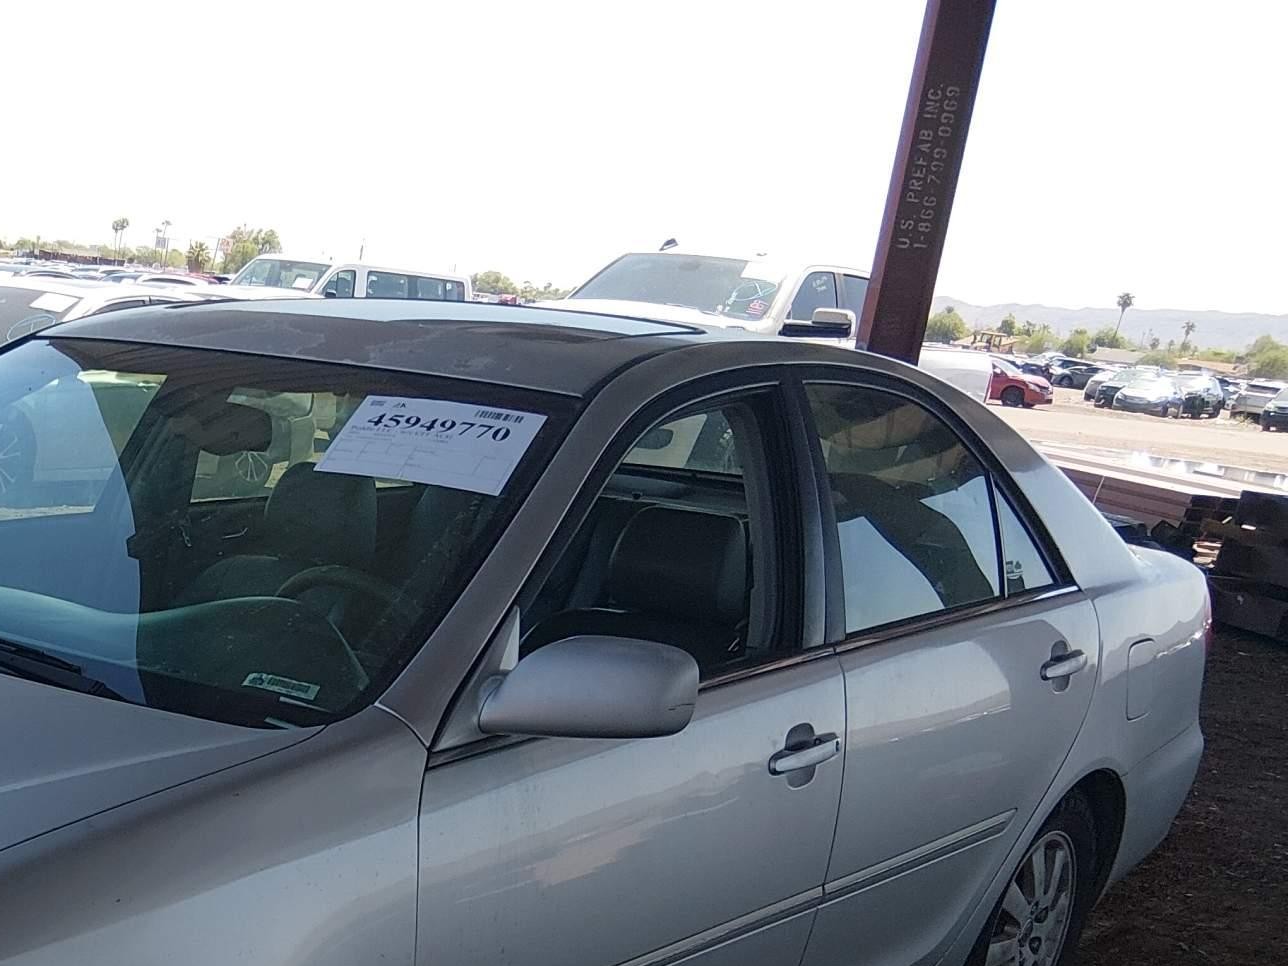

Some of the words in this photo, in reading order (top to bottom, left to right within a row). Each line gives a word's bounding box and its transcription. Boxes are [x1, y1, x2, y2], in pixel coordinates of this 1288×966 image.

[922, 82, 946, 121] INC.
[905, 128, 935, 204] PREFAB
[913, 85, 961, 250] 1-866-799-0969
[896, 214, 917, 250] U.S.
[367, 412, 512, 442] 45949770
